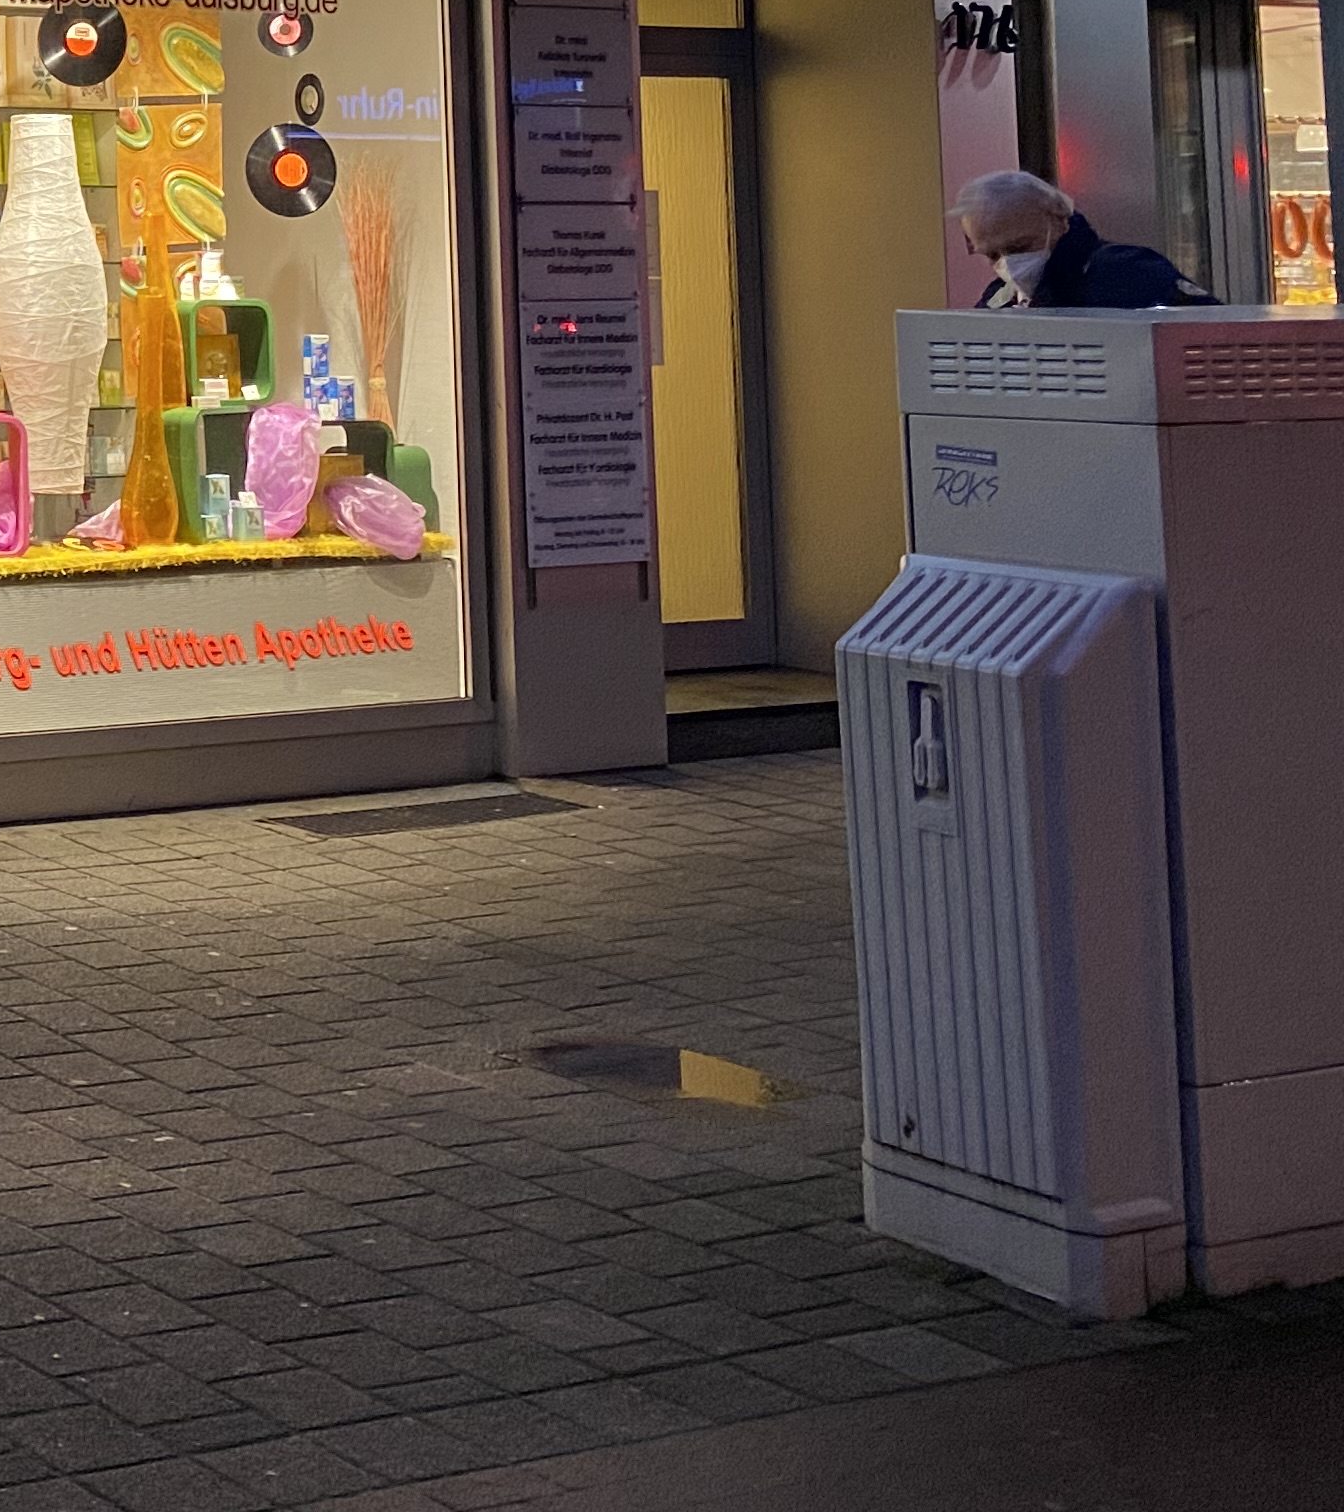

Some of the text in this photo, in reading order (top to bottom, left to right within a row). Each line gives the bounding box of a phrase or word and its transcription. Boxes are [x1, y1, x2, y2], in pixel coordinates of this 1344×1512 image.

[51, 631, 122, 677] und
[126, 625, 246, 673] Hütten
[253, 614, 414, 670] Apotheke
